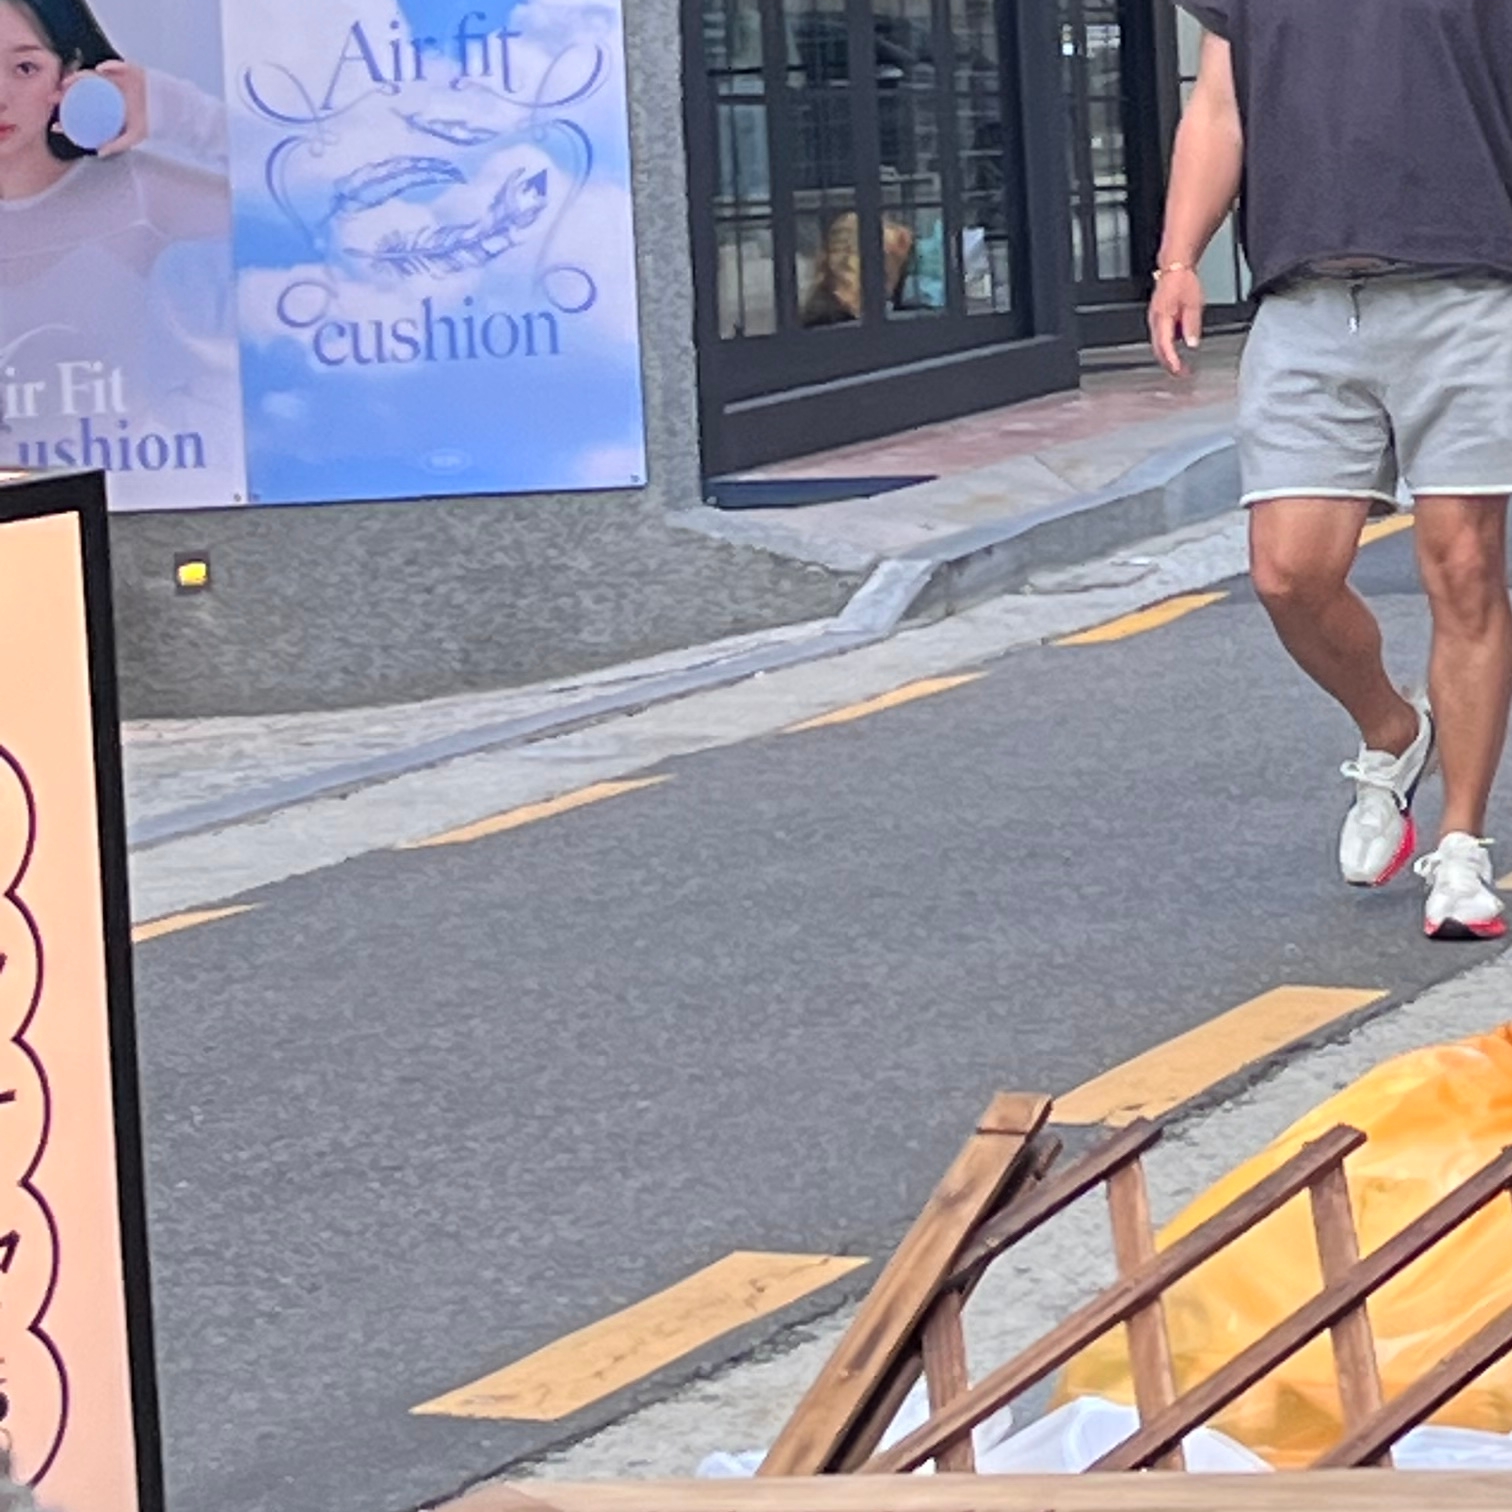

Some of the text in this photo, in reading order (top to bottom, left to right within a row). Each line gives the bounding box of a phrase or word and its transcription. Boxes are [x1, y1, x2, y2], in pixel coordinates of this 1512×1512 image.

[319, 11, 522, 110] Air fit
[312, 295, 560, 367] cushion
[3, 360, 127, 419] ir Fit
[0, 416, 206, 472] ushion
